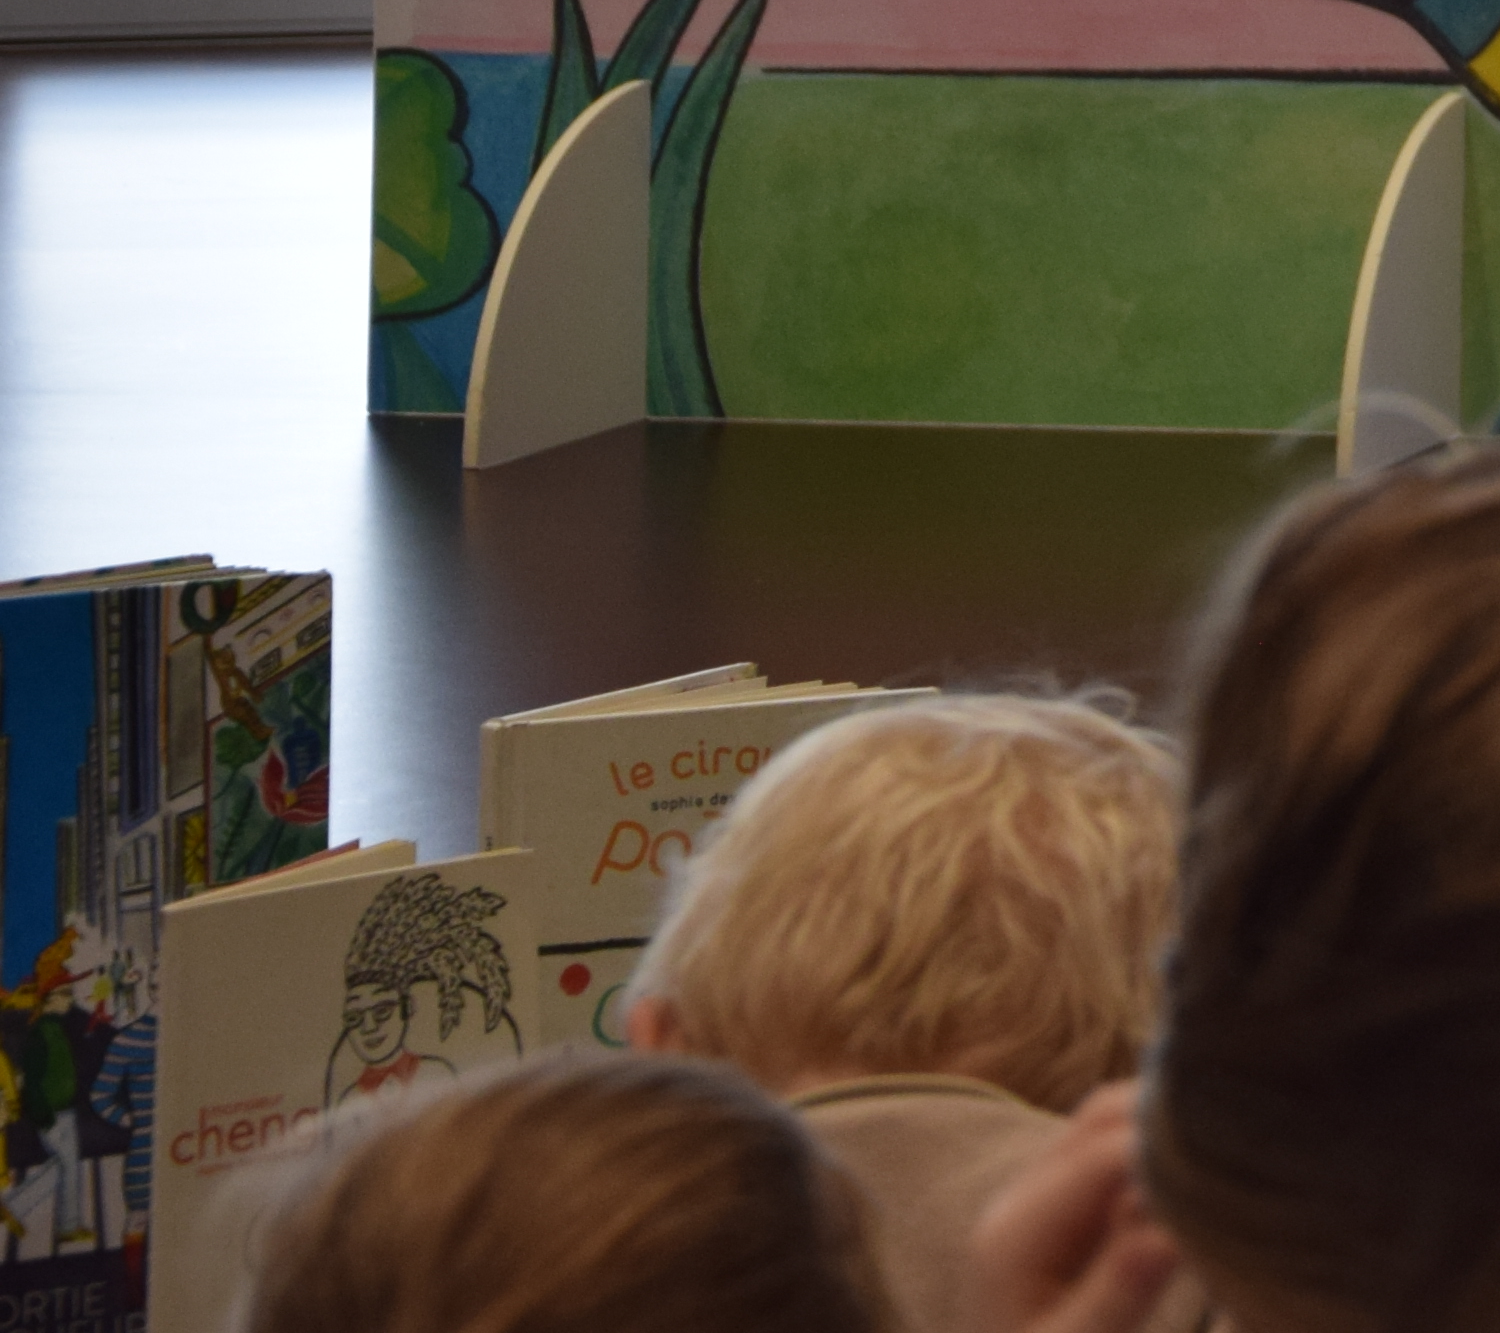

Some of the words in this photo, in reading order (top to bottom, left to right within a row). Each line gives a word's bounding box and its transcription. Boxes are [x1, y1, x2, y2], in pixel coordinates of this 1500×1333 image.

[608, 760, 656, 796] le
[651, 795, 704, 813] sophie
[0, 1280, 108, 1330] ORTIE
